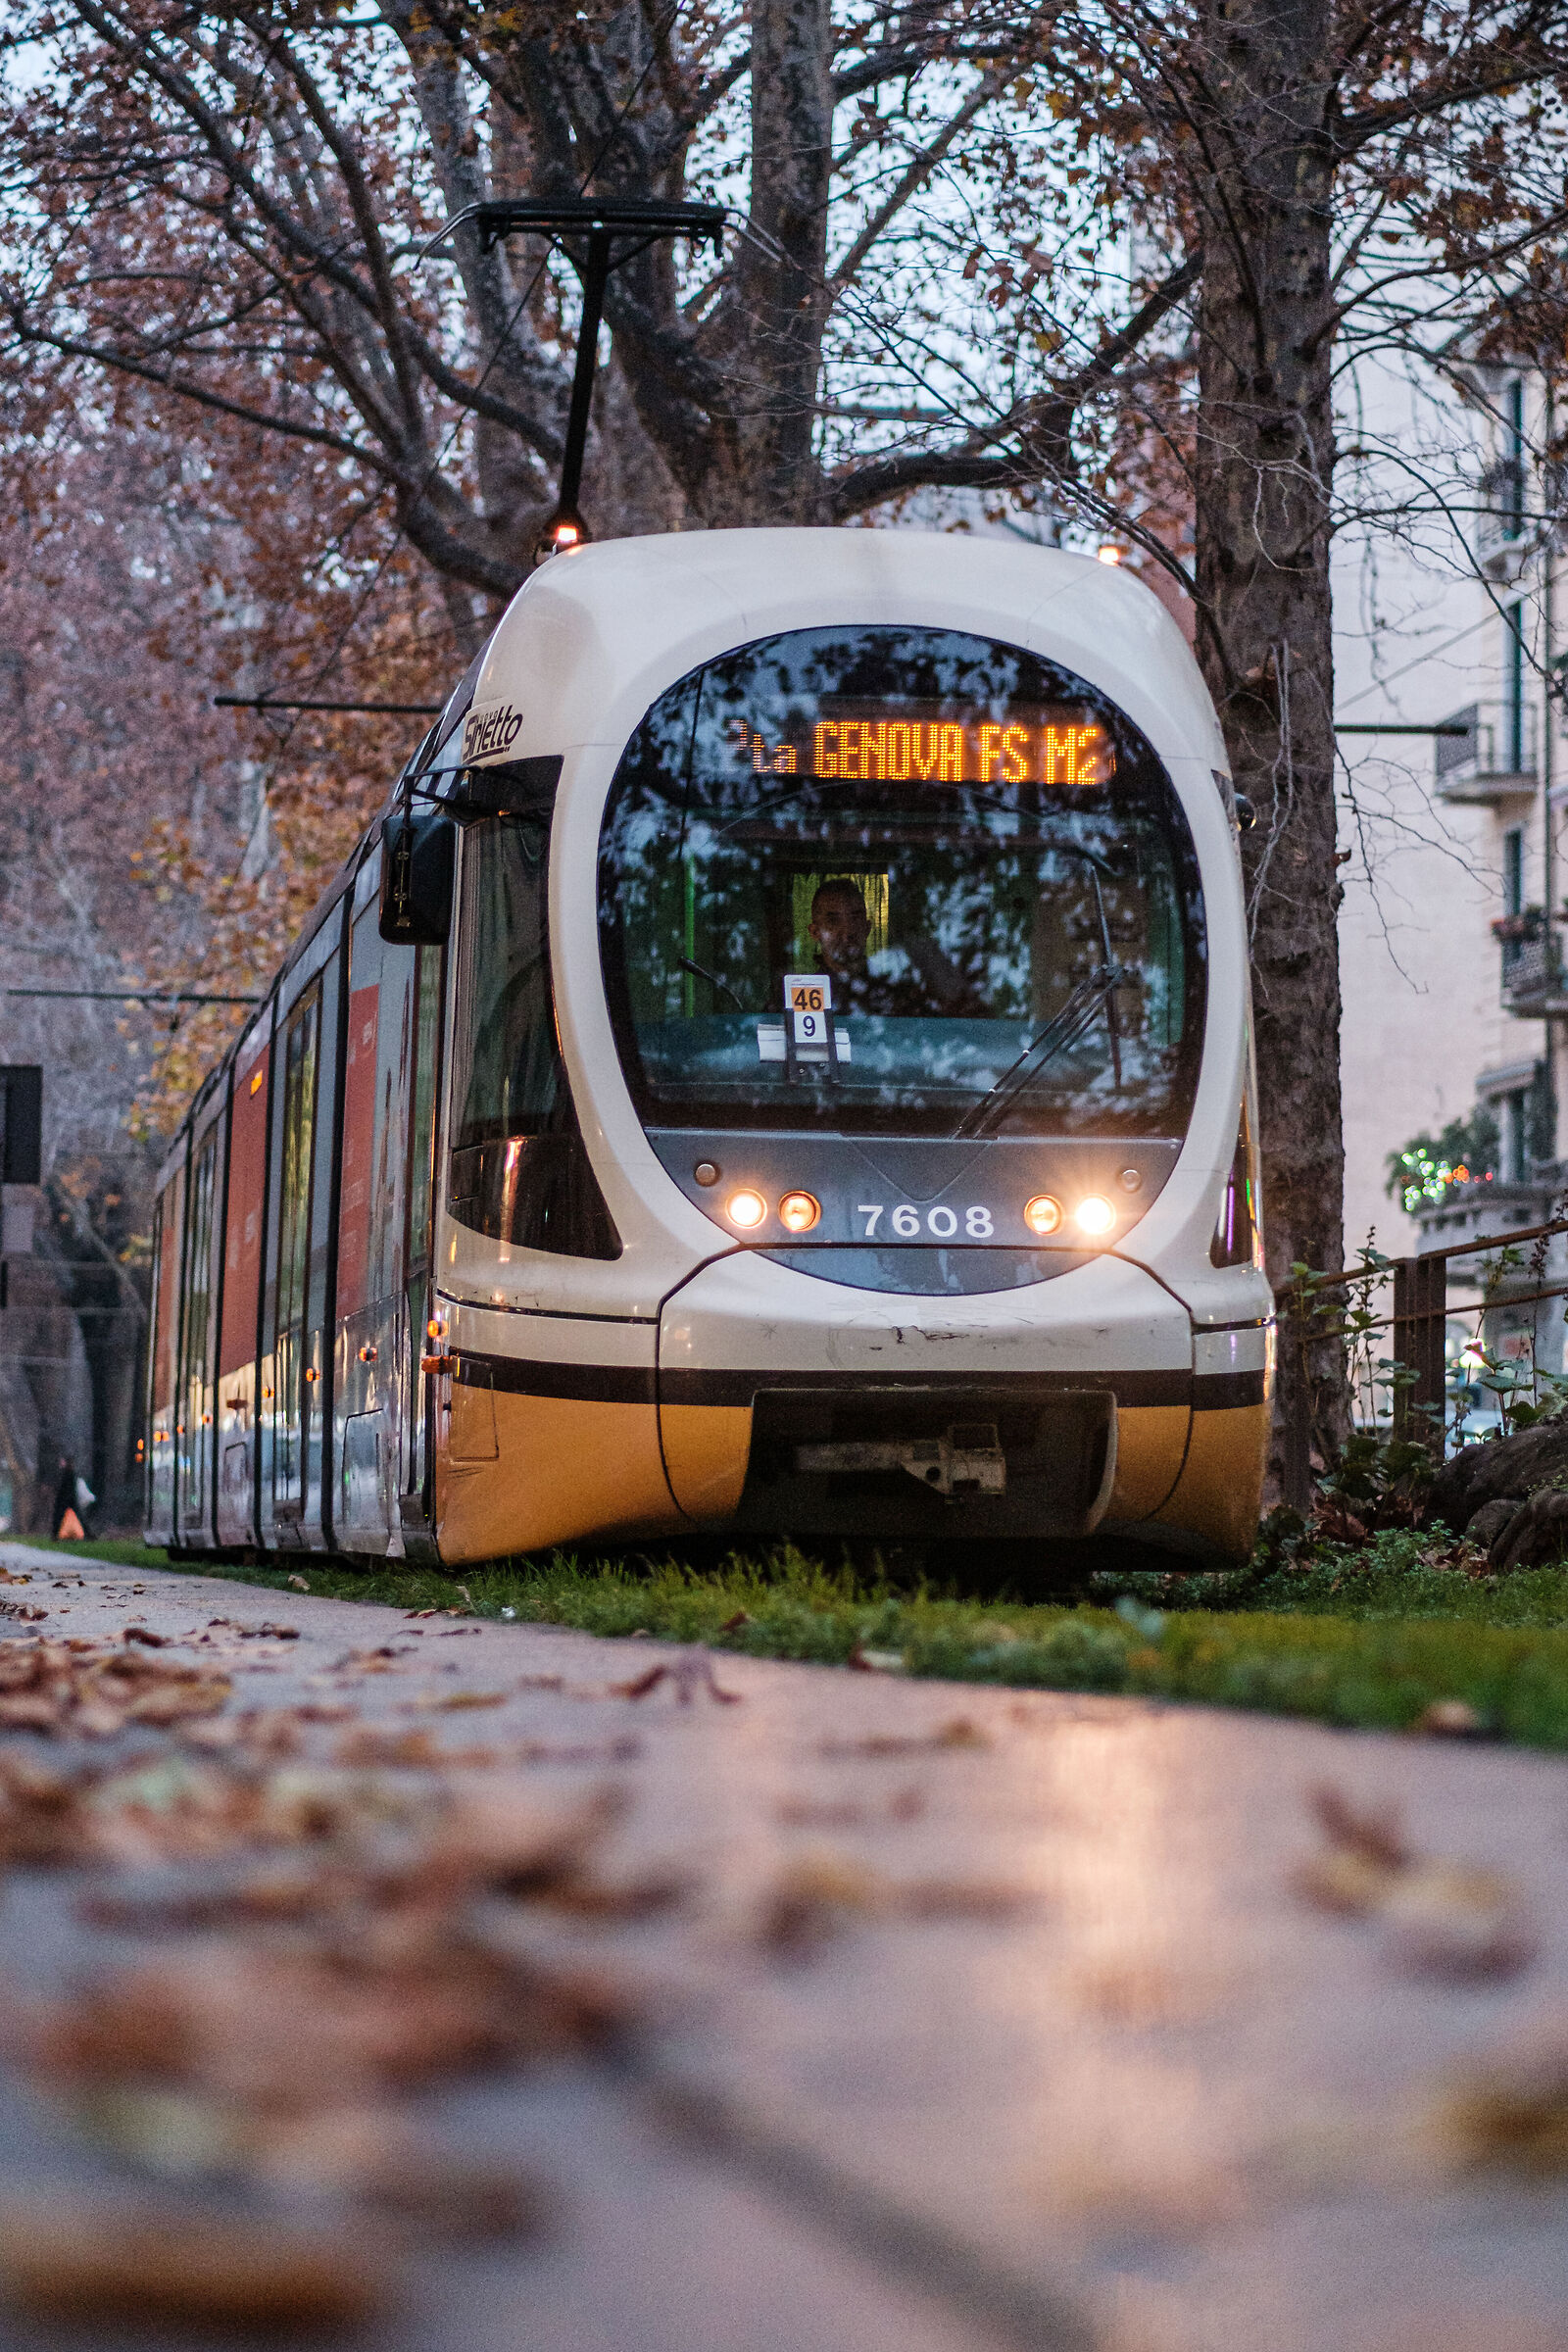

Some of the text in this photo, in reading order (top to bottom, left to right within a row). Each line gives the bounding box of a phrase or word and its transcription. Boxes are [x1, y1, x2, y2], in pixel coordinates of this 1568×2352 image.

[814, 720, 962, 782] GENOVA
[980, 725, 1028, 783] FS
[1046, 727, 1097, 784] M2
[794, 989, 822, 1010] 46
[803, 1015, 815, 1037] 9
[858, 1204, 995, 1239] 7608
